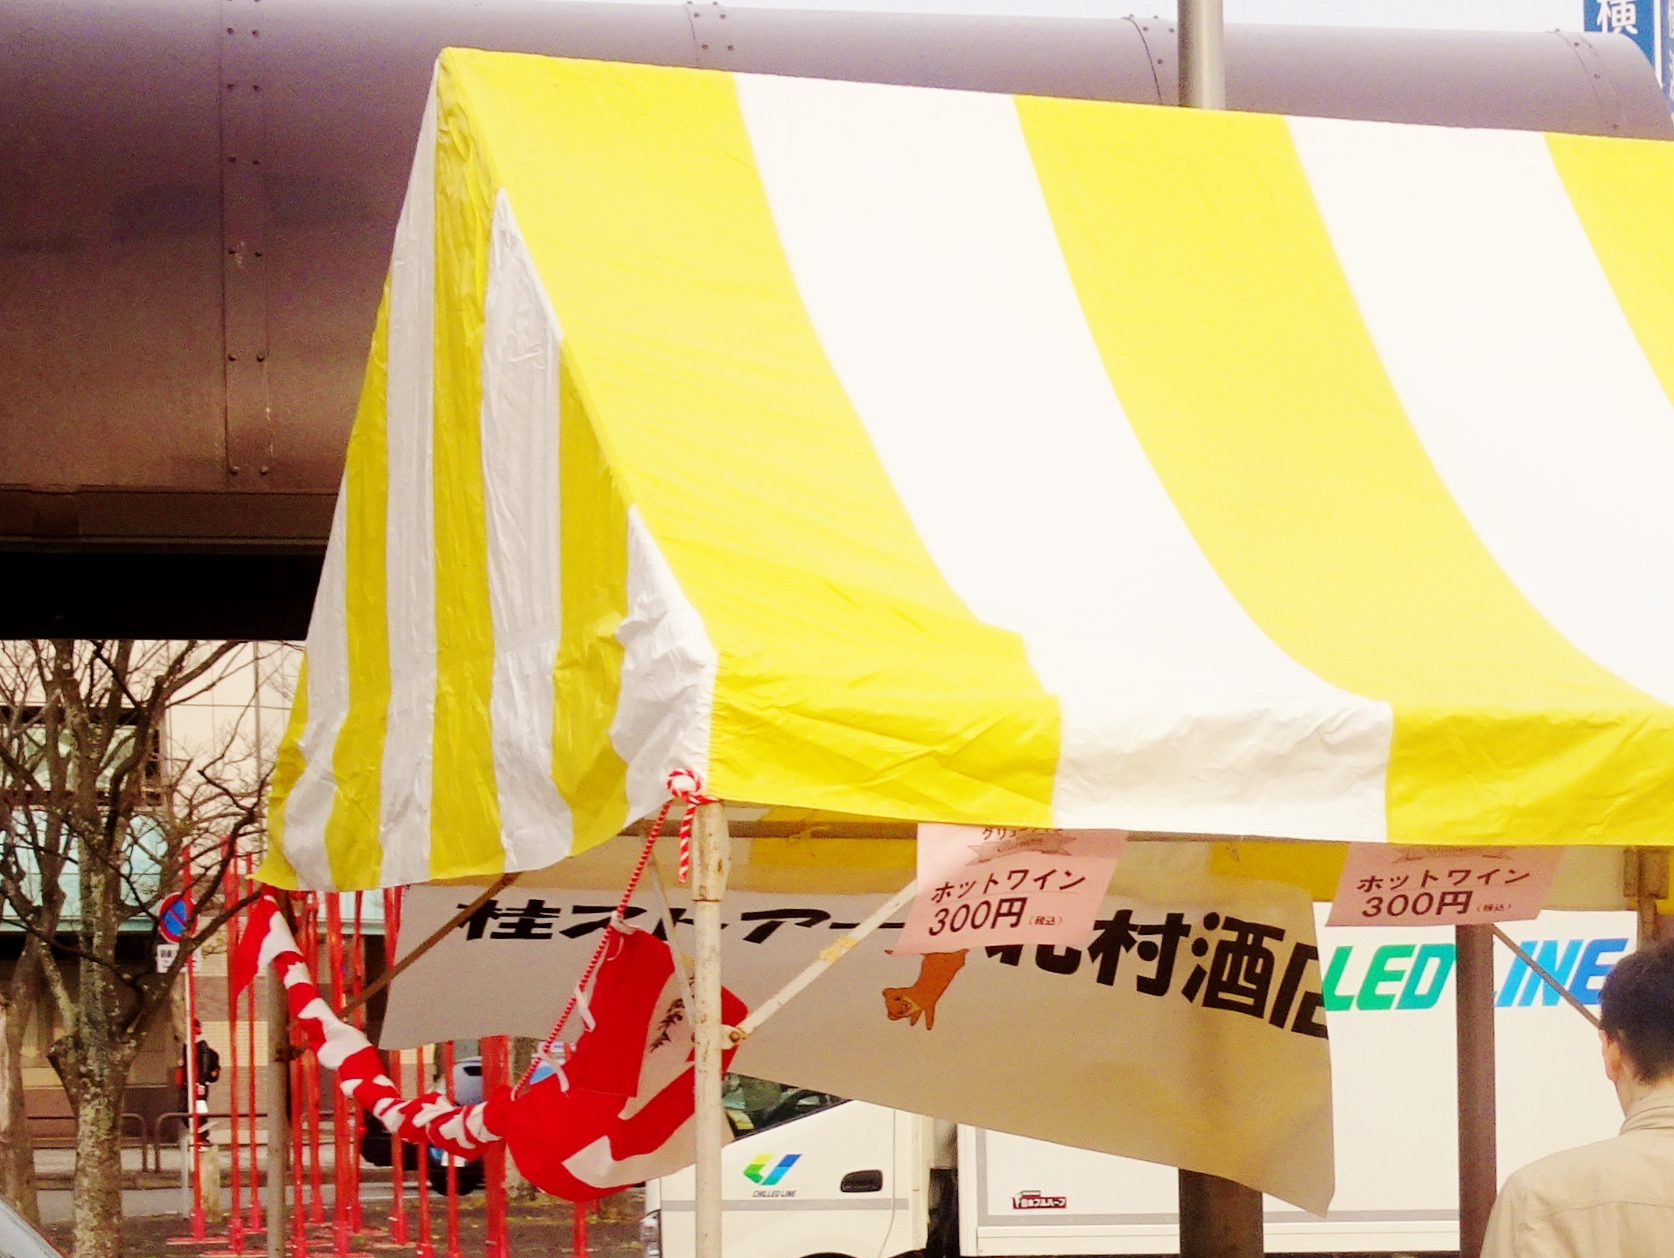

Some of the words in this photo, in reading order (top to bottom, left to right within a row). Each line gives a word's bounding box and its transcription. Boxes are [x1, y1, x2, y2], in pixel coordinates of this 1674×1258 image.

[931, 868, 1087, 904] ホットワイン
[1356, 868, 1531, 893] ホットワイン
[929, 897, 1028, 937] 300円
[1361, 890, 1474, 918] 300円
